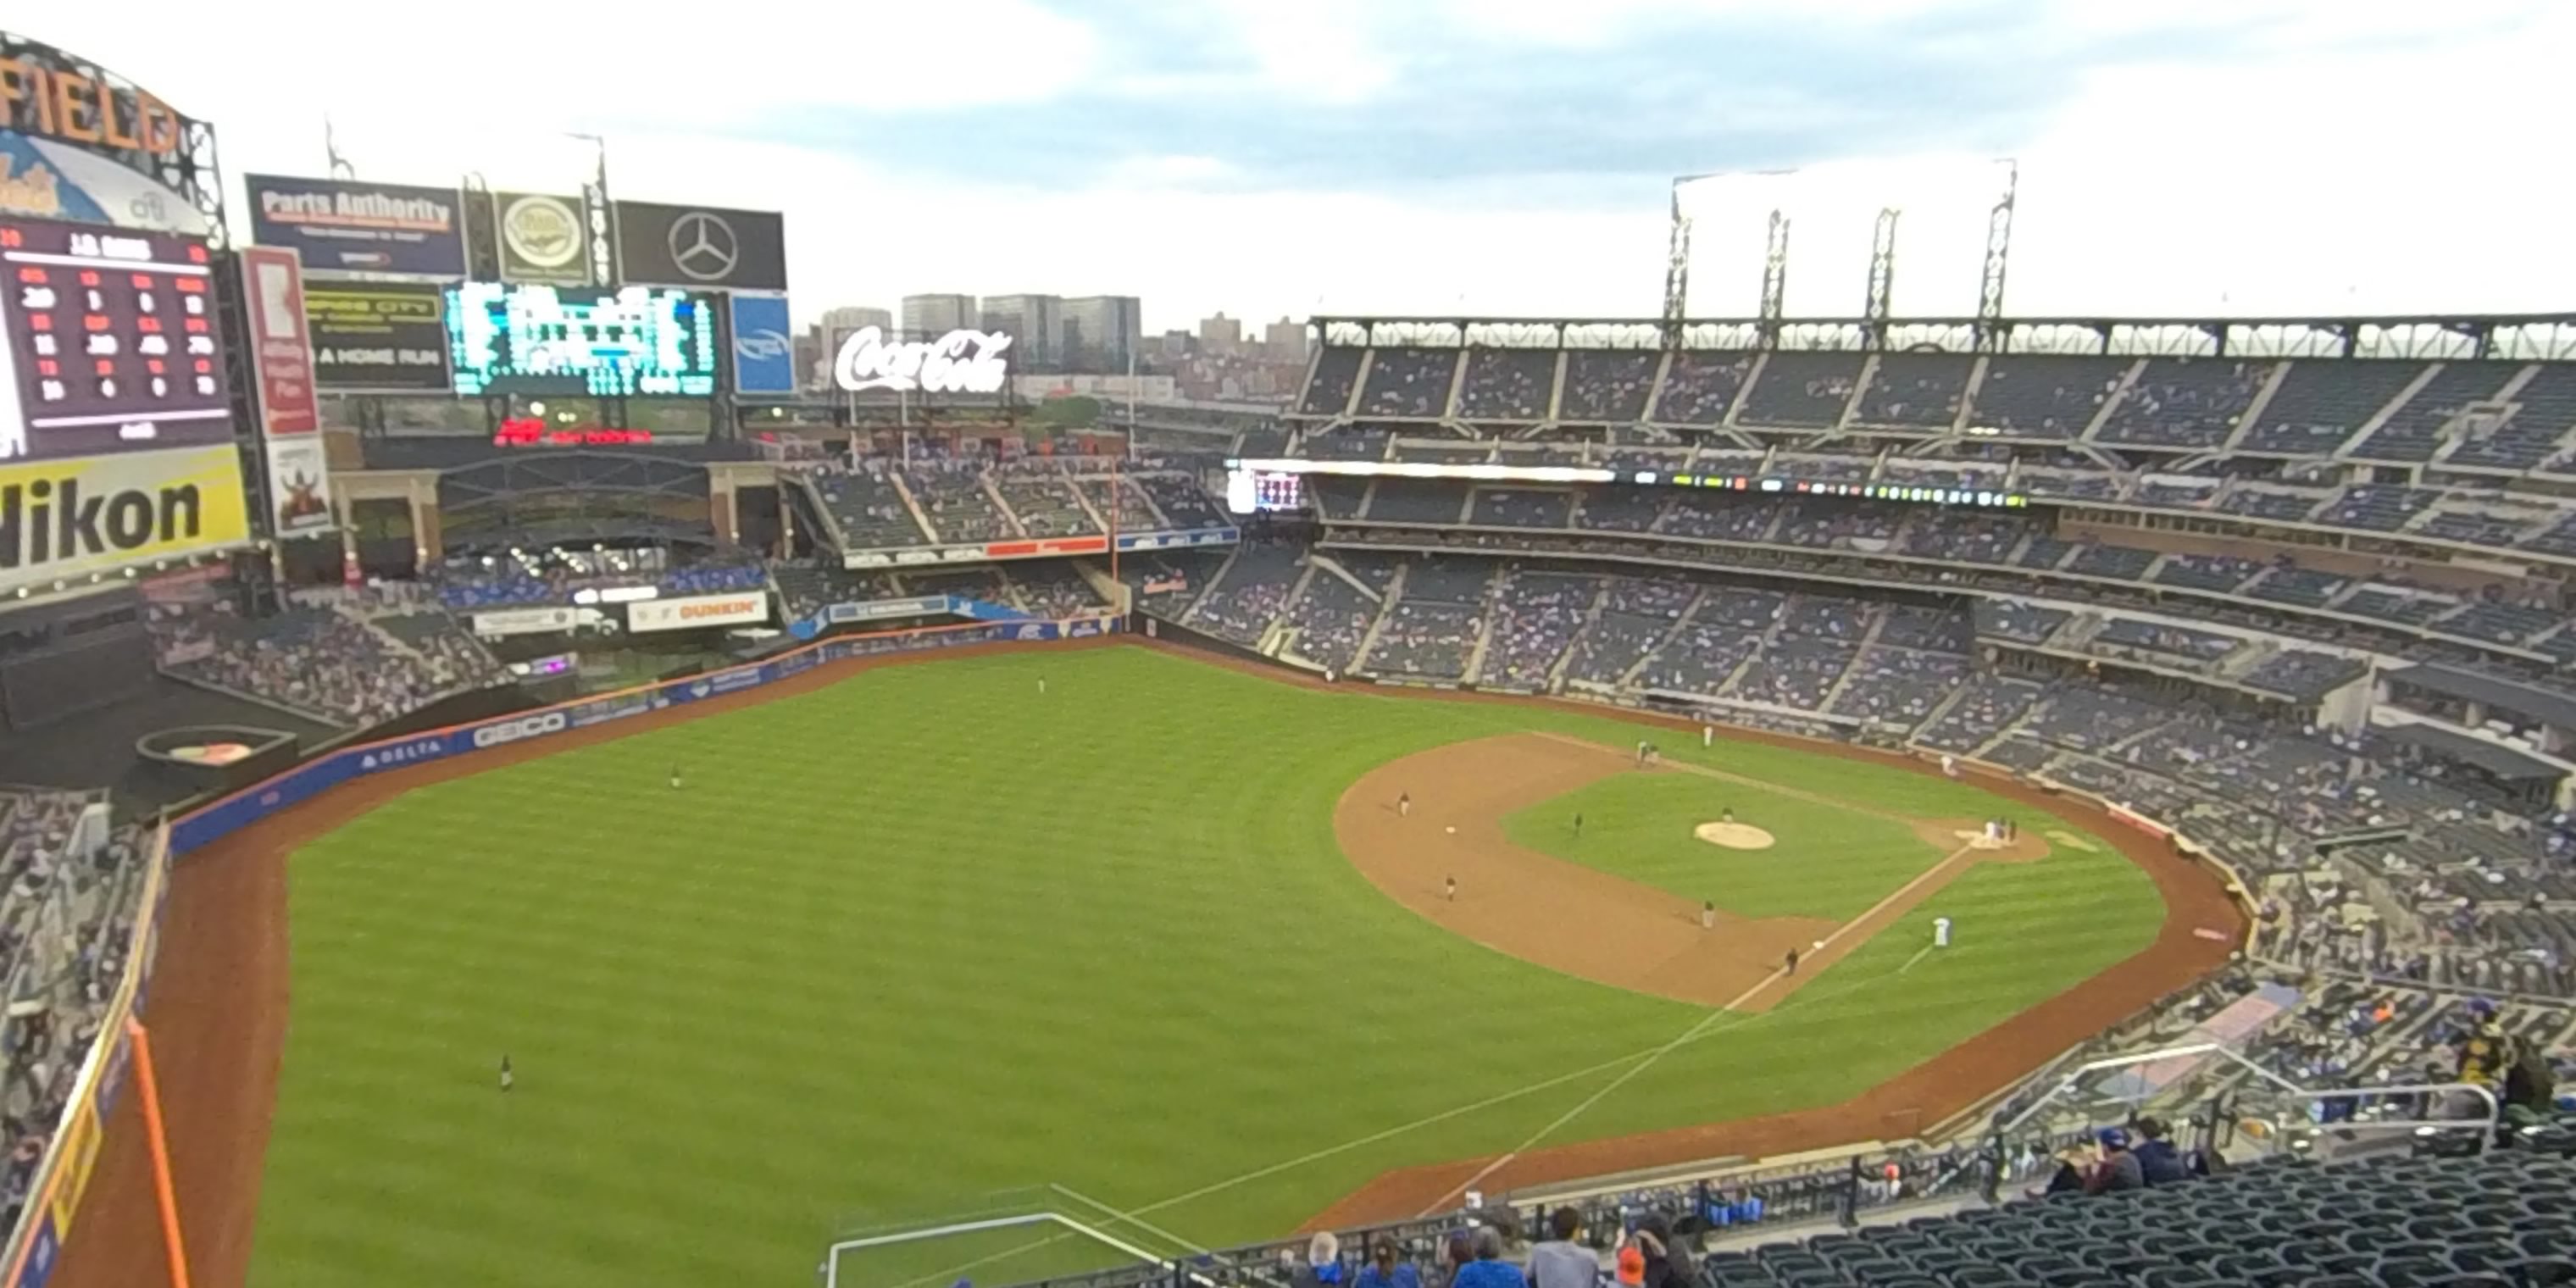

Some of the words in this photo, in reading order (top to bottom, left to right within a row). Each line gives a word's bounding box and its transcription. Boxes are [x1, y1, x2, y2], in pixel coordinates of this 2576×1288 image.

[0, 56, 180, 153] FIELD
[262, 191, 330, 215] Parts
[336, 192, 451, 224] Authority
[474, 712, 566, 747] GEICO
[380, 740, 442, 764] DELTA
